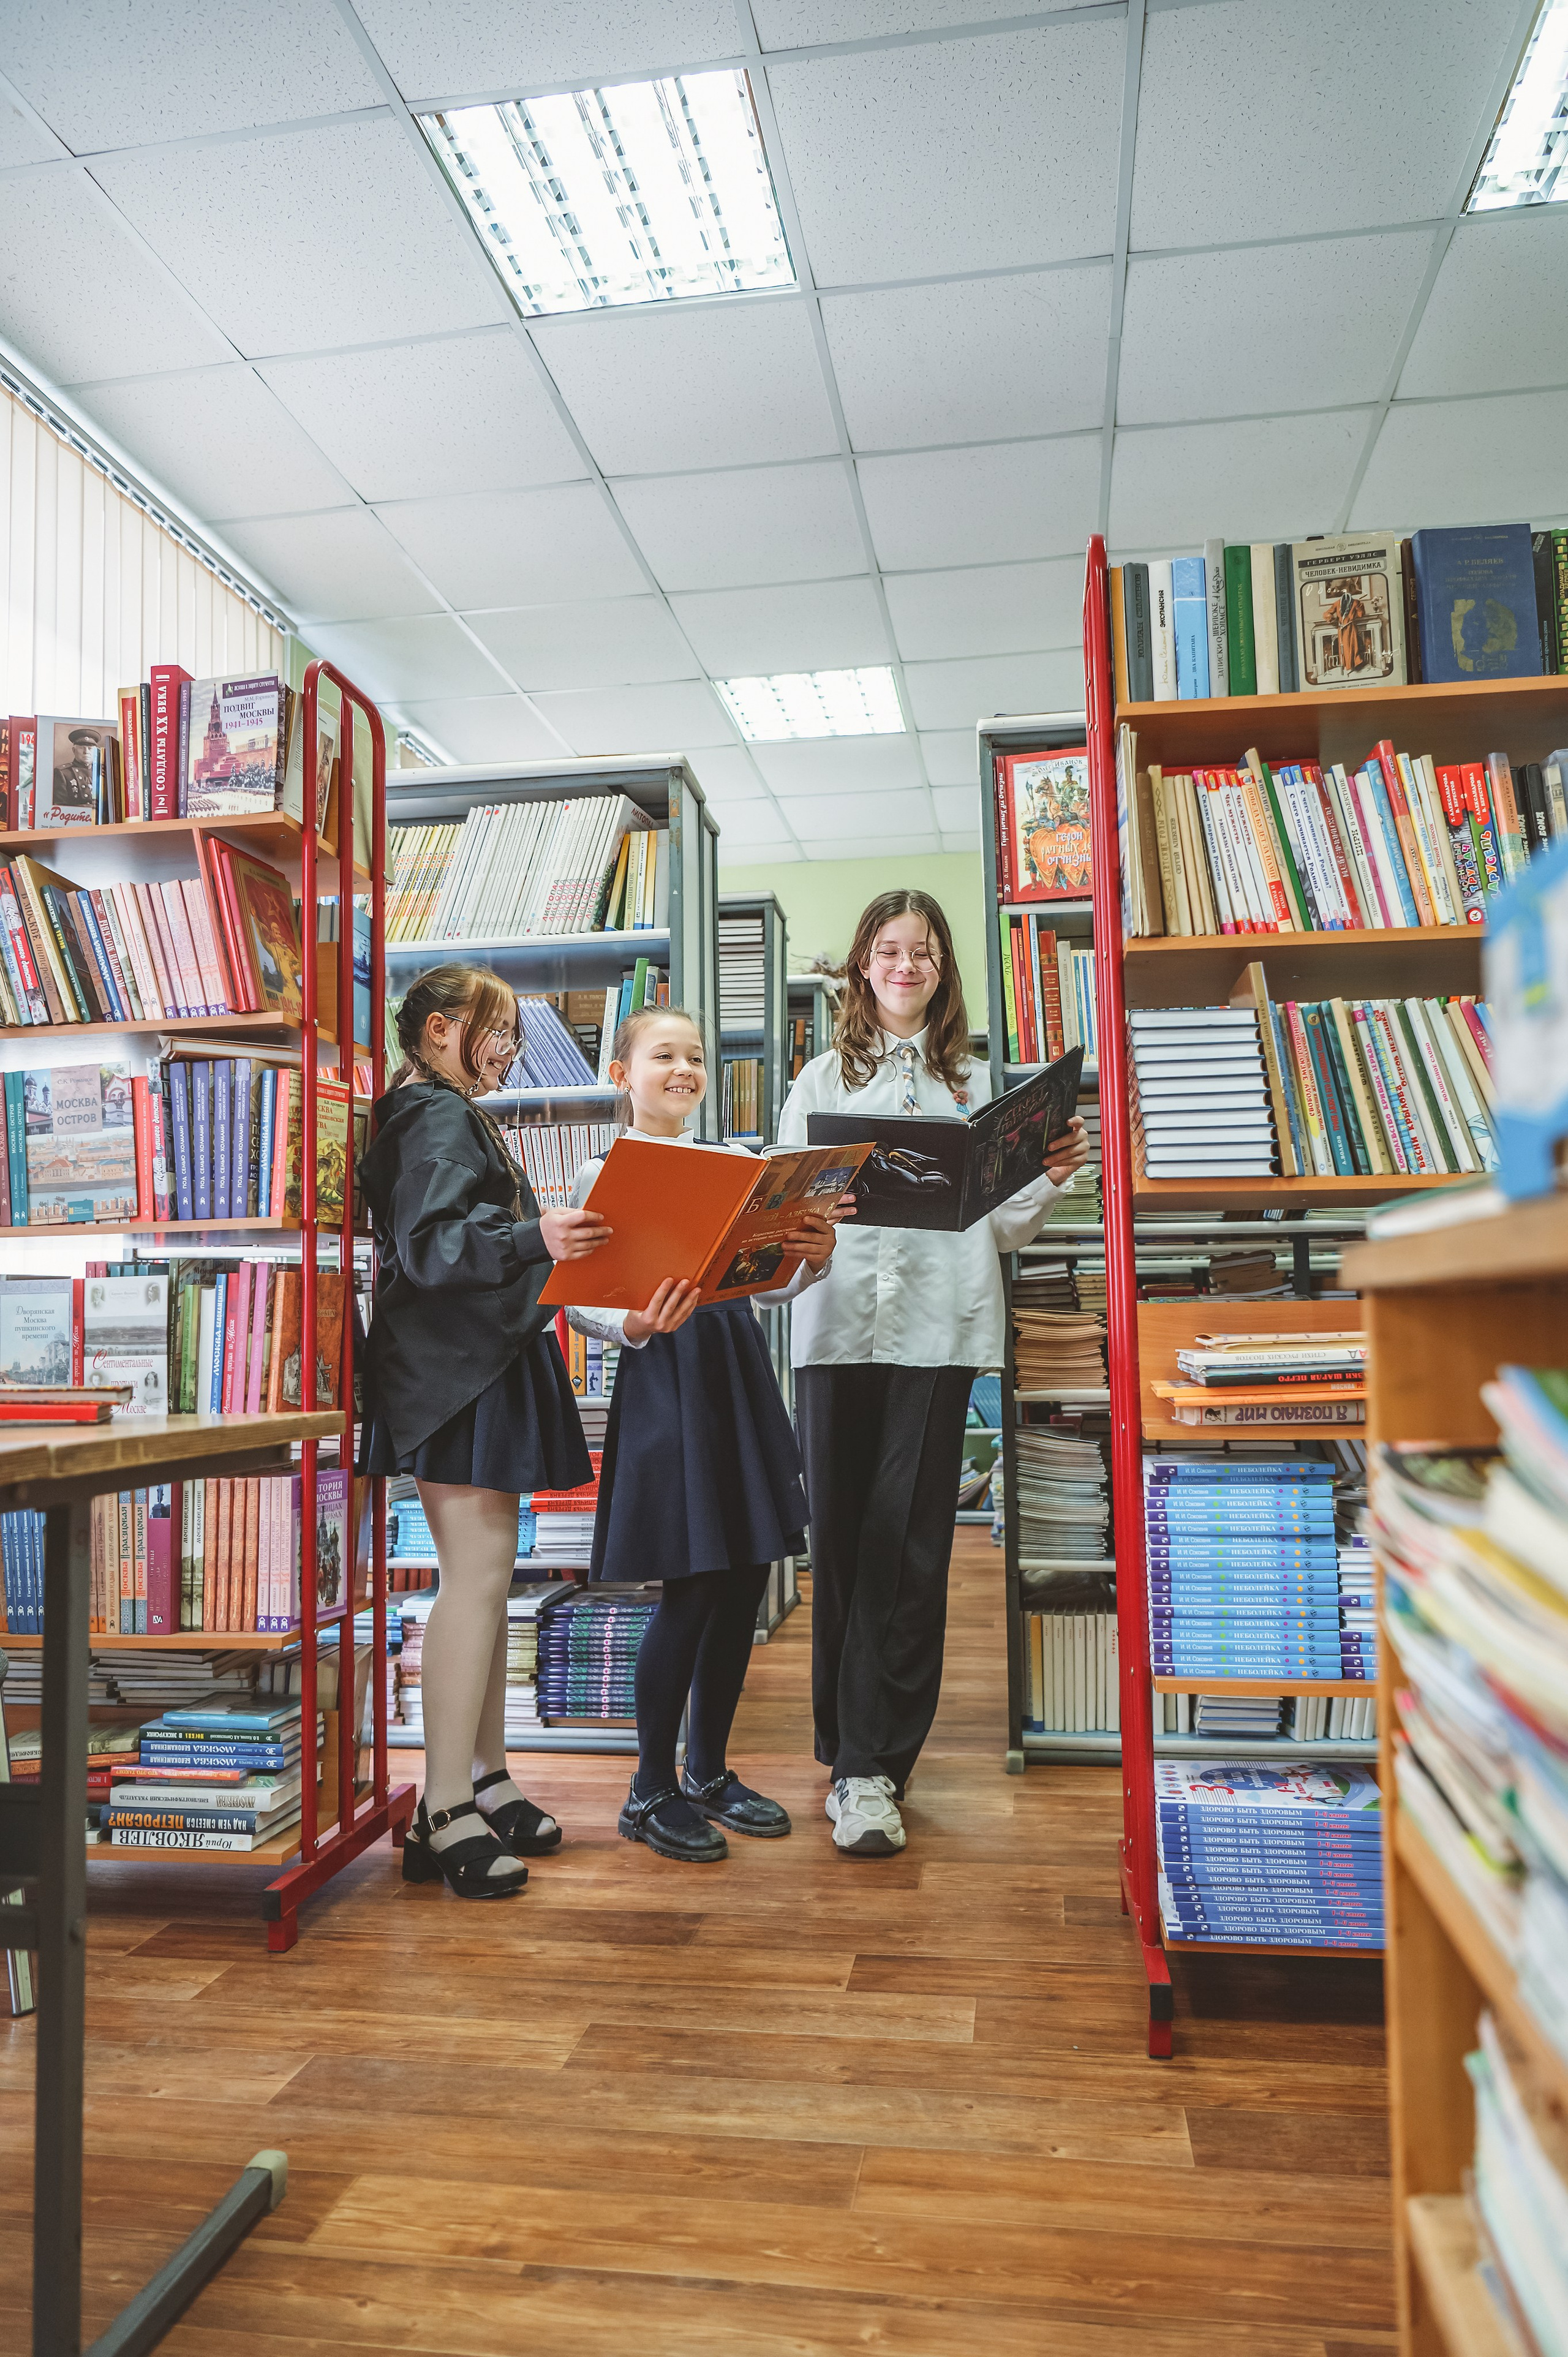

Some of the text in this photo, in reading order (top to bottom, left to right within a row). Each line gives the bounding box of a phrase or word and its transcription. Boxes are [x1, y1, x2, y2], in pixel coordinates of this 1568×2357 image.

[1305, 562, 1381, 577] ЧЕЛОВЕК-НЕВИДИМКА
[1307, 556, 1345, 565] ГЕРБЕРТ
[158, 685, 167, 713] ВЕКА
[224, 703, 255, 713] ПОДВИГ
[239, 709, 274, 719] МОСКВЫ
[156, 738, 167, 791] СОЛДАТЫ
[1338, 777, 1354, 820] ОБЪЕКТИВЕ
[1443, 772, 1453, 816] АЛЕКСАНДРОВА
[1201, 794, 1222, 881] Сказки народов России
[1227, 809, 1240, 845] мужества
[1246, 787, 1276, 880] ПОБЕДА БУДЕТ ЗА НАМИ!
[1351, 829, 1364, 856] ЦИРК
[1290, 800, 1299, 817] чего
[1295, 818, 1312, 861] начинается
[1306, 862, 1321, 892] Родина?
[1427, 823, 1442, 868] Лесной голосок
[1461, 843, 1479, 893] ТРУБАЧ
[43, 892, 58, 923] ЭКСКУРСИЯХ
[543, 880, 560, 922] ЛИСТОПАД
[586, 877, 601, 919] ЛИСТОПАД
[81, 899, 111, 982] МОСКВА БЕЛОКАМЕННАЯ
[4, 946, 16, 974] ИСТОРИЯ
[13, 933, 26, 960] нашего
[20, 959, 37, 990] детства
[33, 942, 56, 996] интересно!
[13, 979, 23, 1001] ЛАРИНА
[1379, 1010, 1407, 1087] ОСТРОВ НЕЗНАЙКИ
[1298, 1057, 1309, 1081] ЗМЕЮ
[1424, 1042, 1450, 1102] ВОЛШЕБНОЕ СЛОВО
[56, 1098, 97, 1109] МОСКВА
[1303, 1083, 1316, 1117] СВОБОДУ
[1374, 1074, 1389, 1110] КРИВЫХ
[57, 1114, 97, 1125] ОСТРОВ
[151, 1093, 160, 1124] детства
[153, 1125, 161, 1150] нашего
[1384, 1112, 1406, 1169] КОРОЛЕВСТВО
[16, 1306, 55, 1316] Дворянская
[212, 1284, 224, 1375] МОСКВА БЕЛОКАМЕННАЯ
[93, 1349, 153, 1369] Сентиментальные
[1234, 1405, 1348, 1421] Я ПОЗНАЮ МИР
[318, 1480, 342, 1492] ТОРИЯ
[193, 1744, 236, 1754] МОСКВА
[216, 1795, 255, 1808] МОСКВА
[108, 1812, 247, 1830] НАД ЧЕМ СМЕЕТСЯ ПЕТРОСЯН?
[119, 1830, 232, 1849] Юрий ЯКОВЛЕВ
